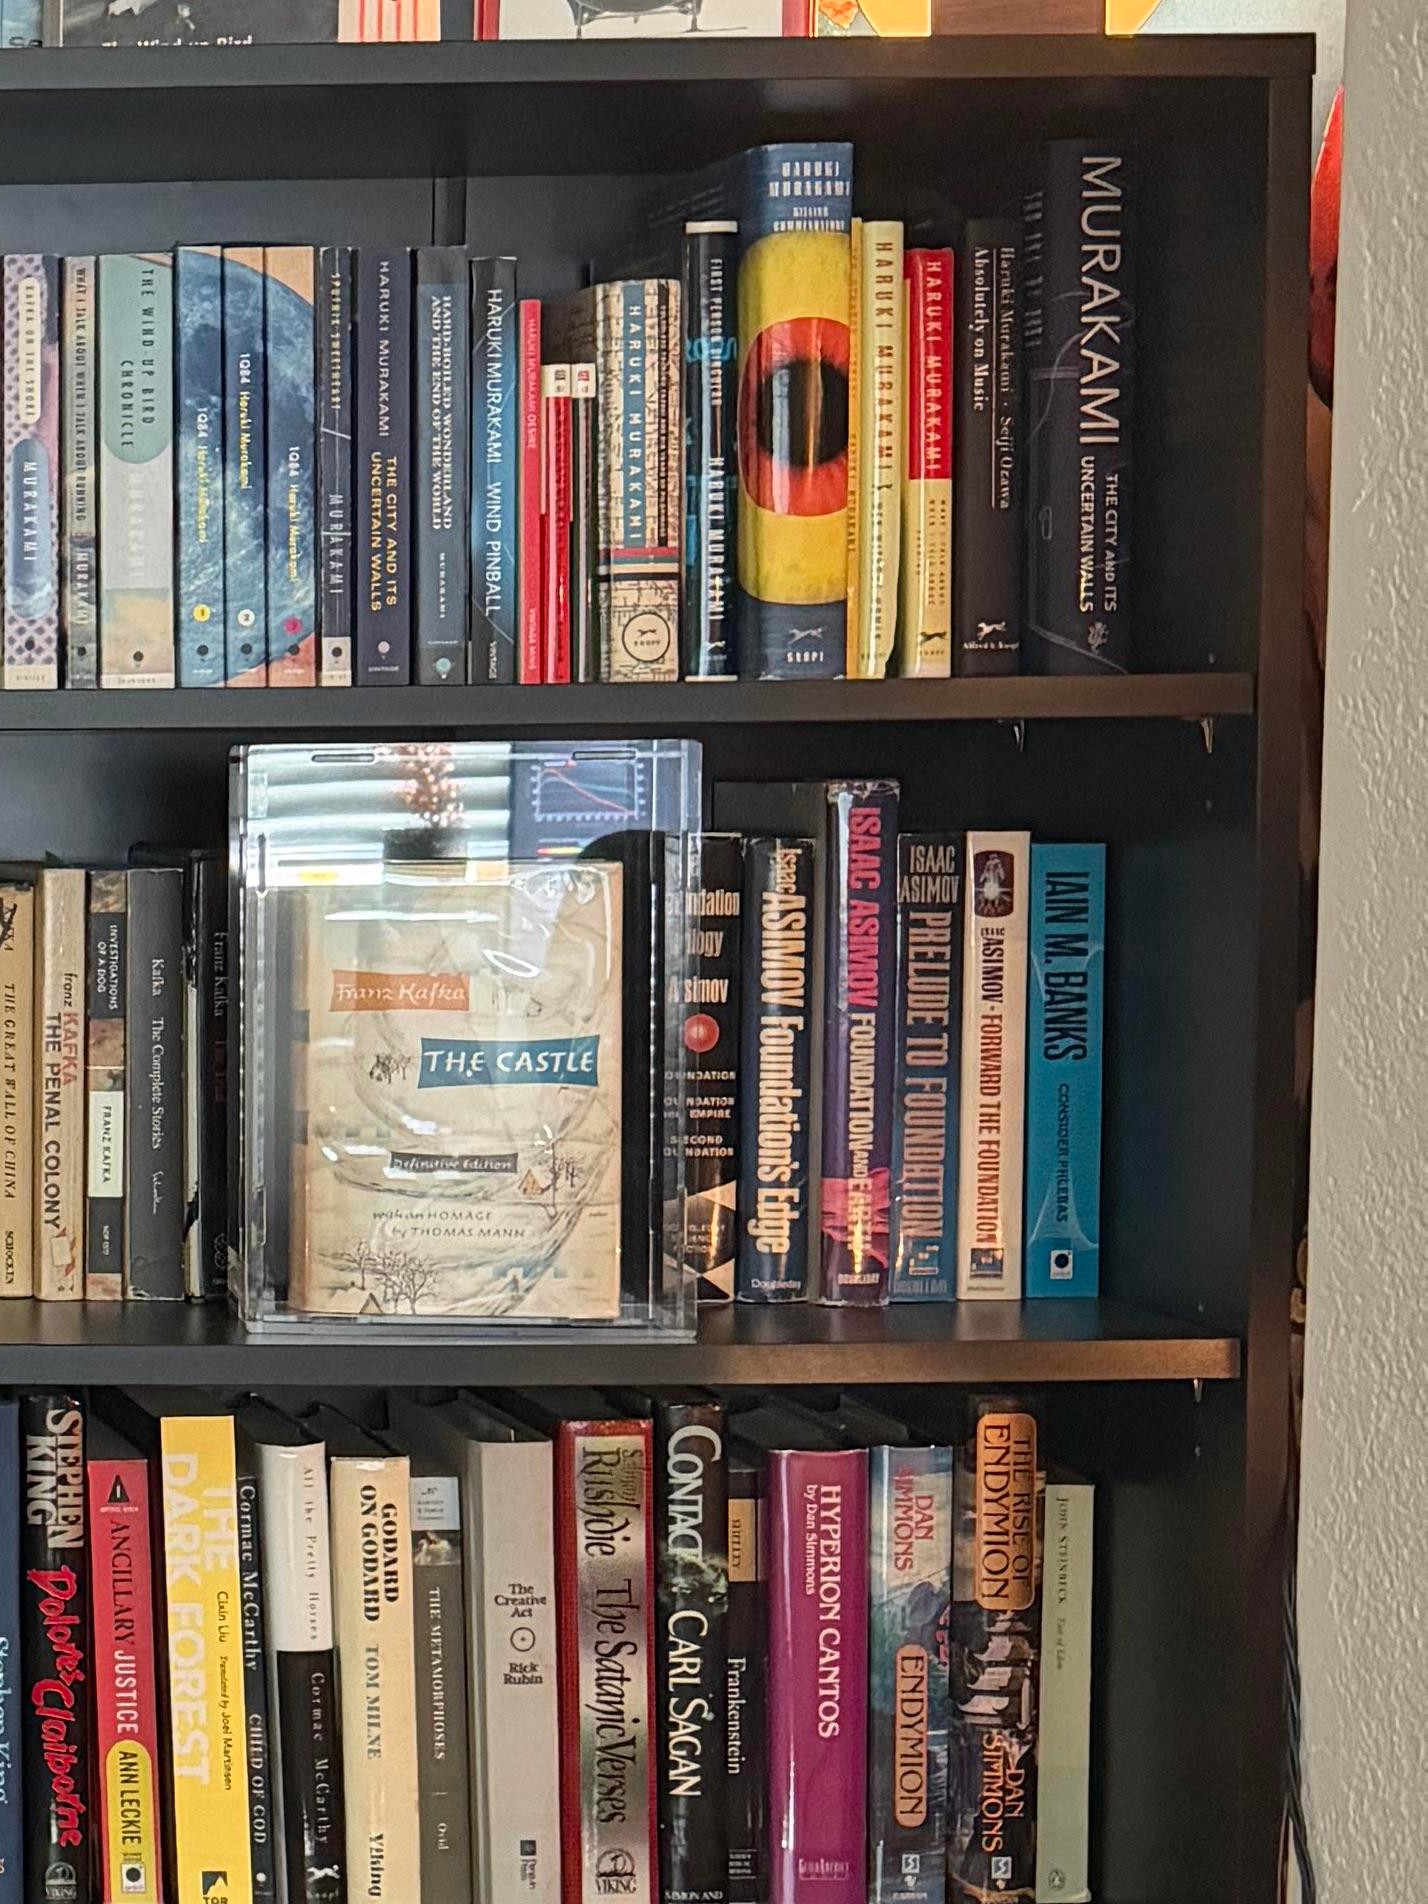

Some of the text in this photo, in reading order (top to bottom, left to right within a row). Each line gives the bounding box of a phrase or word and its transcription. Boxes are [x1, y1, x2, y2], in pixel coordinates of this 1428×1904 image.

[1080, 156, 1122, 445] MURAKAMI
[485, 287, 503, 617] HARUKI MURAKAMI WIND PINBALL
[848, 807, 883, 1008] ISAAC ASIMOV
[1043, 871, 1090, 1063] IAIN BANKS
[495, 1046, 599, 1075] CASTLE
[901, 911, 952, 1239] PRELUDE FOUNDATION
[411, 1224, 525, 1239] THOMAS MANN
[975, 1140, 1001, 1246] FOUNDATION
[109, 1520, 139, 1735] ANCILLARY JUSTICE
[170, 1603, 210, 1785] FOREST
[503, 1671, 543, 1686] Rubin
[817, 1484, 841, 1740] HYPERION CANTOS
[666, 1695, 712, 1797] SAGAN
[899, 1654, 924, 1817] ENDYMION
